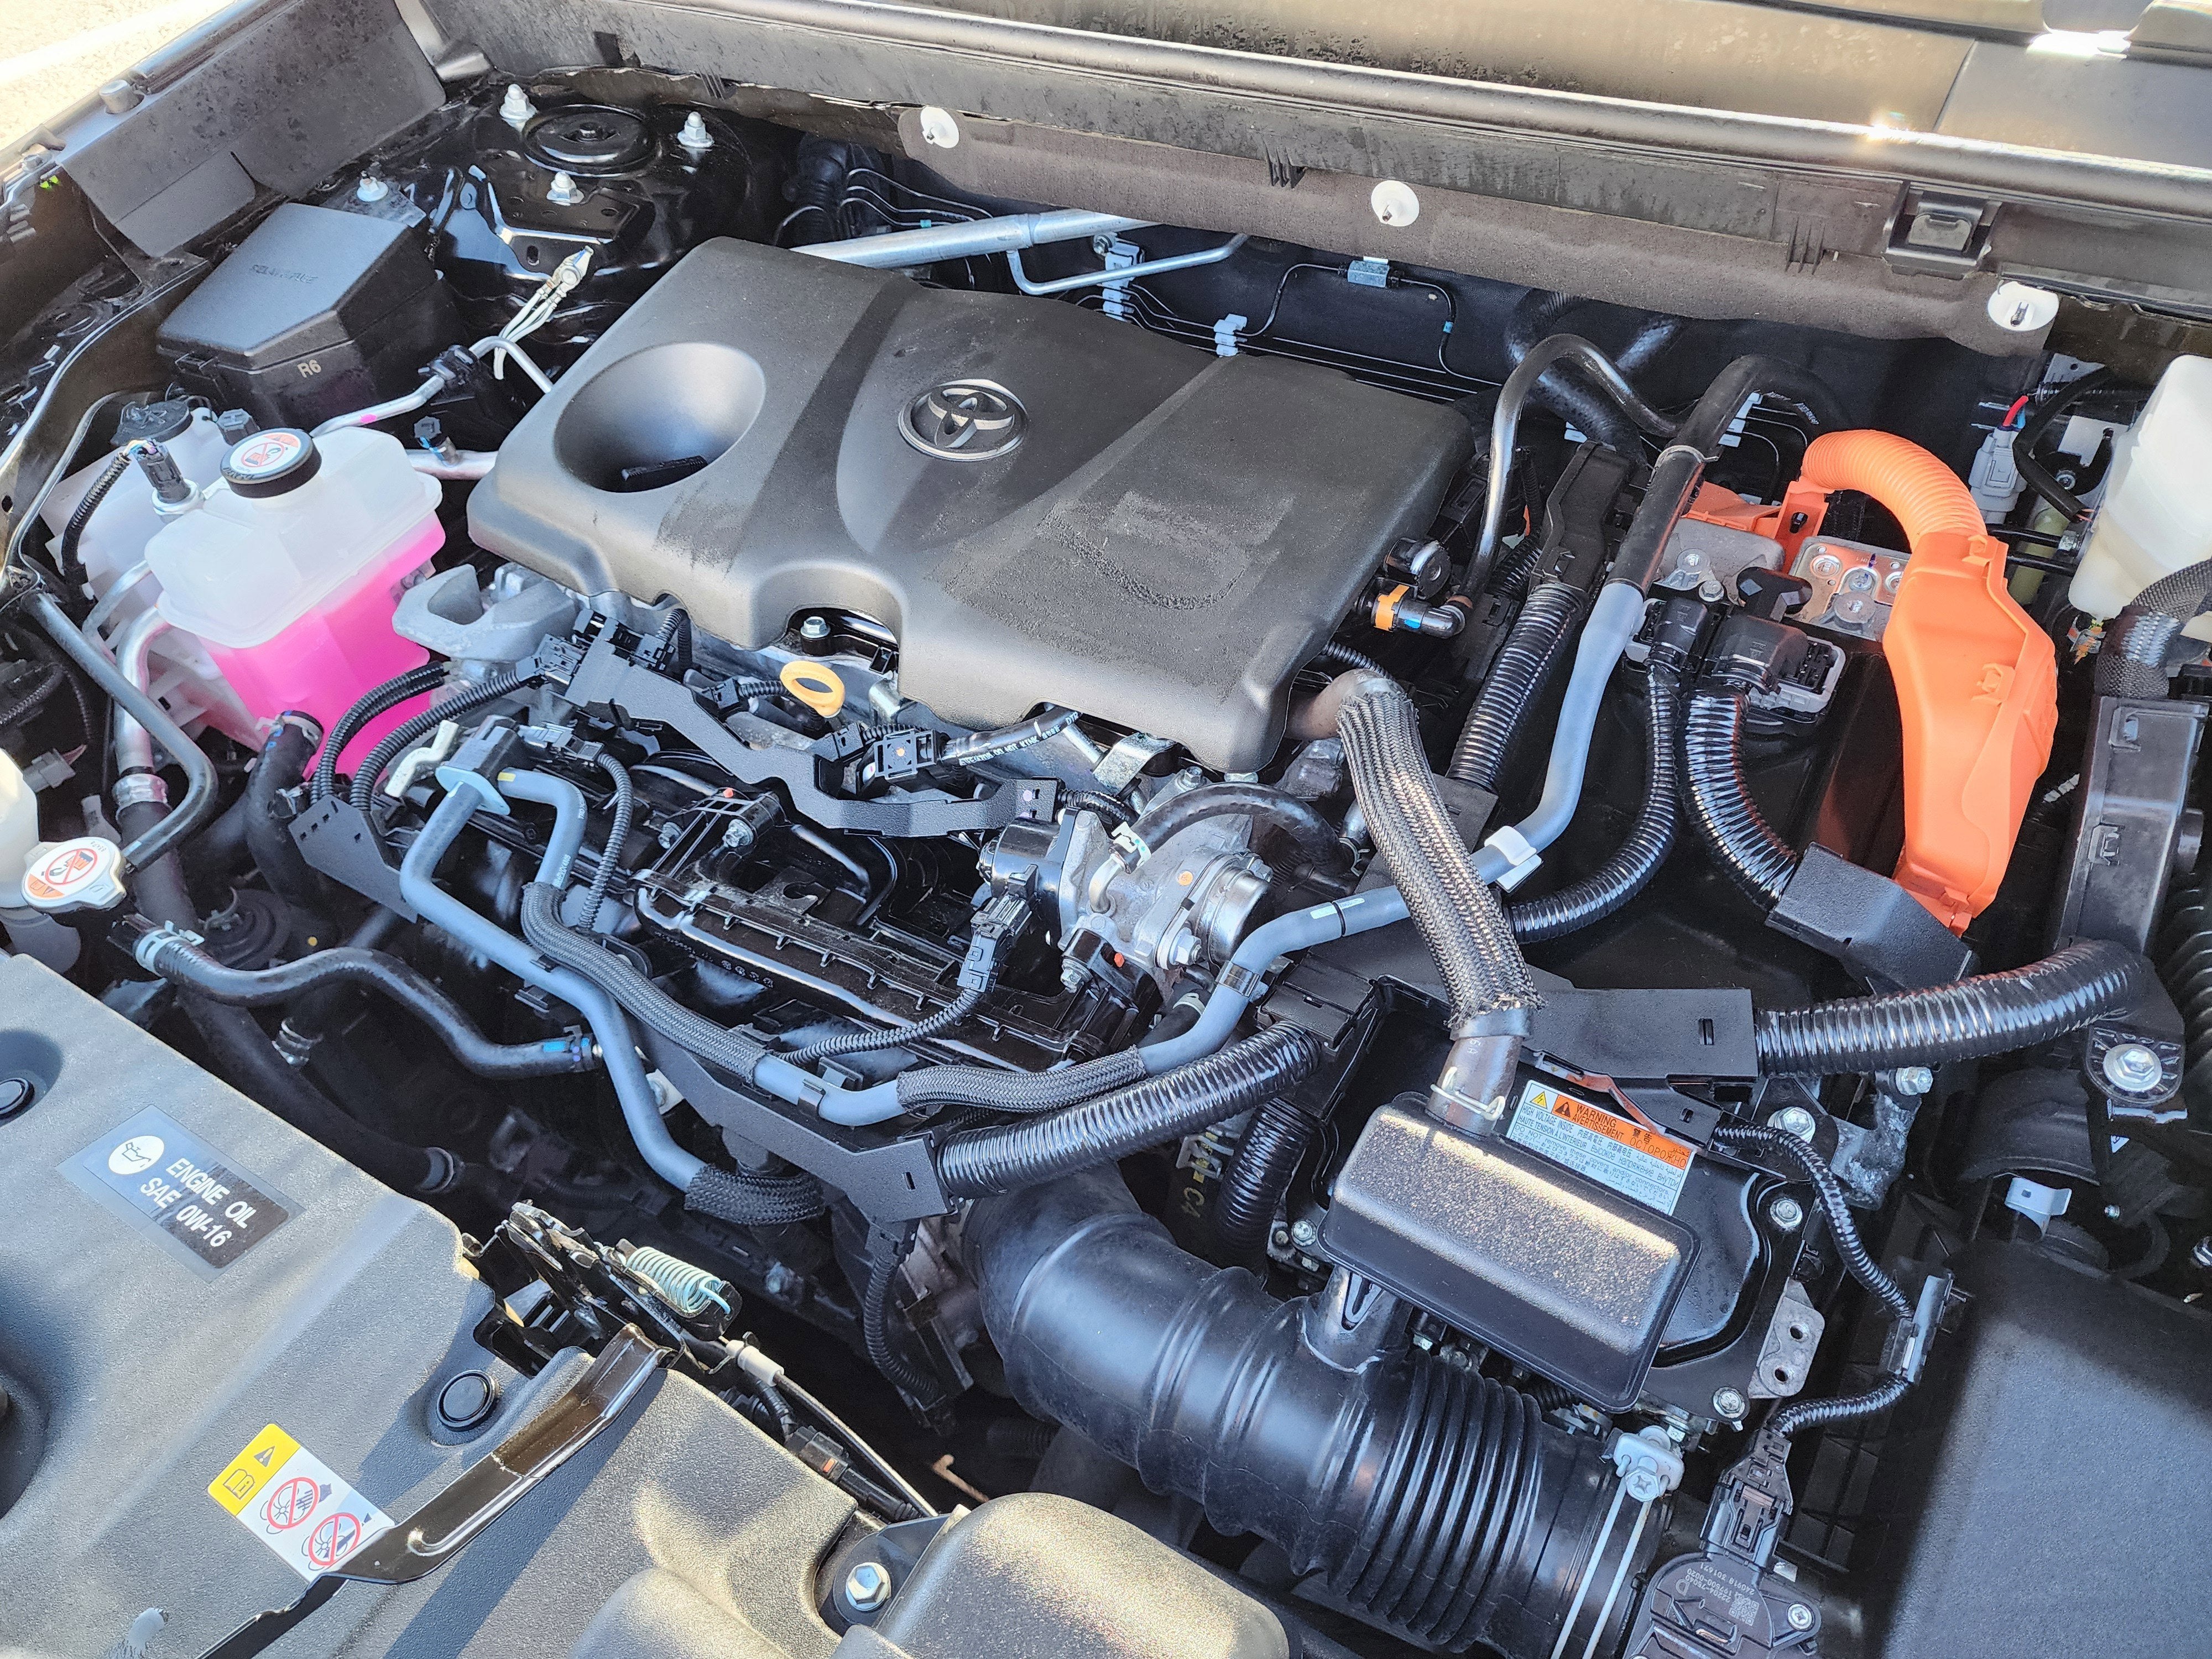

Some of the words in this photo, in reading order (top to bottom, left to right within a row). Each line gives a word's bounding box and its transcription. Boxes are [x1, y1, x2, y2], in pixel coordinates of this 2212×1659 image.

[297, 359, 321, 378] R6
[1517, 1115, 1535, 1127] HAUTE
[1533, 1121, 1554, 1135] TENSION
[1521, 1104, 1535, 1117] HIGH
[1535, 1109, 1557, 1126] VOLTAGE
[1557, 1119, 1574, 1134] INSIDE
[1572, 1112, 1624, 1142] AVERTISSEMENT
[1575, 1104, 1618, 1128] WARNING
[1514, 1124, 1526, 1133] DO
[1527, 1129, 1543, 1140] NOT
[1544, 1137, 1567, 1151] remove
[1569, 1147, 1587, 1159] these
[1589, 1157, 1610, 1169] covers
[1612, 1166, 1632, 1178] and/or
[1634, 1176, 1671, 1195] connectors.
[1590, 1144, 1616, 1160] Высокое
[1617, 1157, 1655, 1178] напряжение
[1629, 1137, 1687, 1167] ОСТОРОЖНО
[166, 1158, 230, 1206] ENGINE
[225, 1201, 257, 1229] OIL
[140, 1177, 182, 1209] SAE
[176, 1204, 232, 1247] 0W-16
